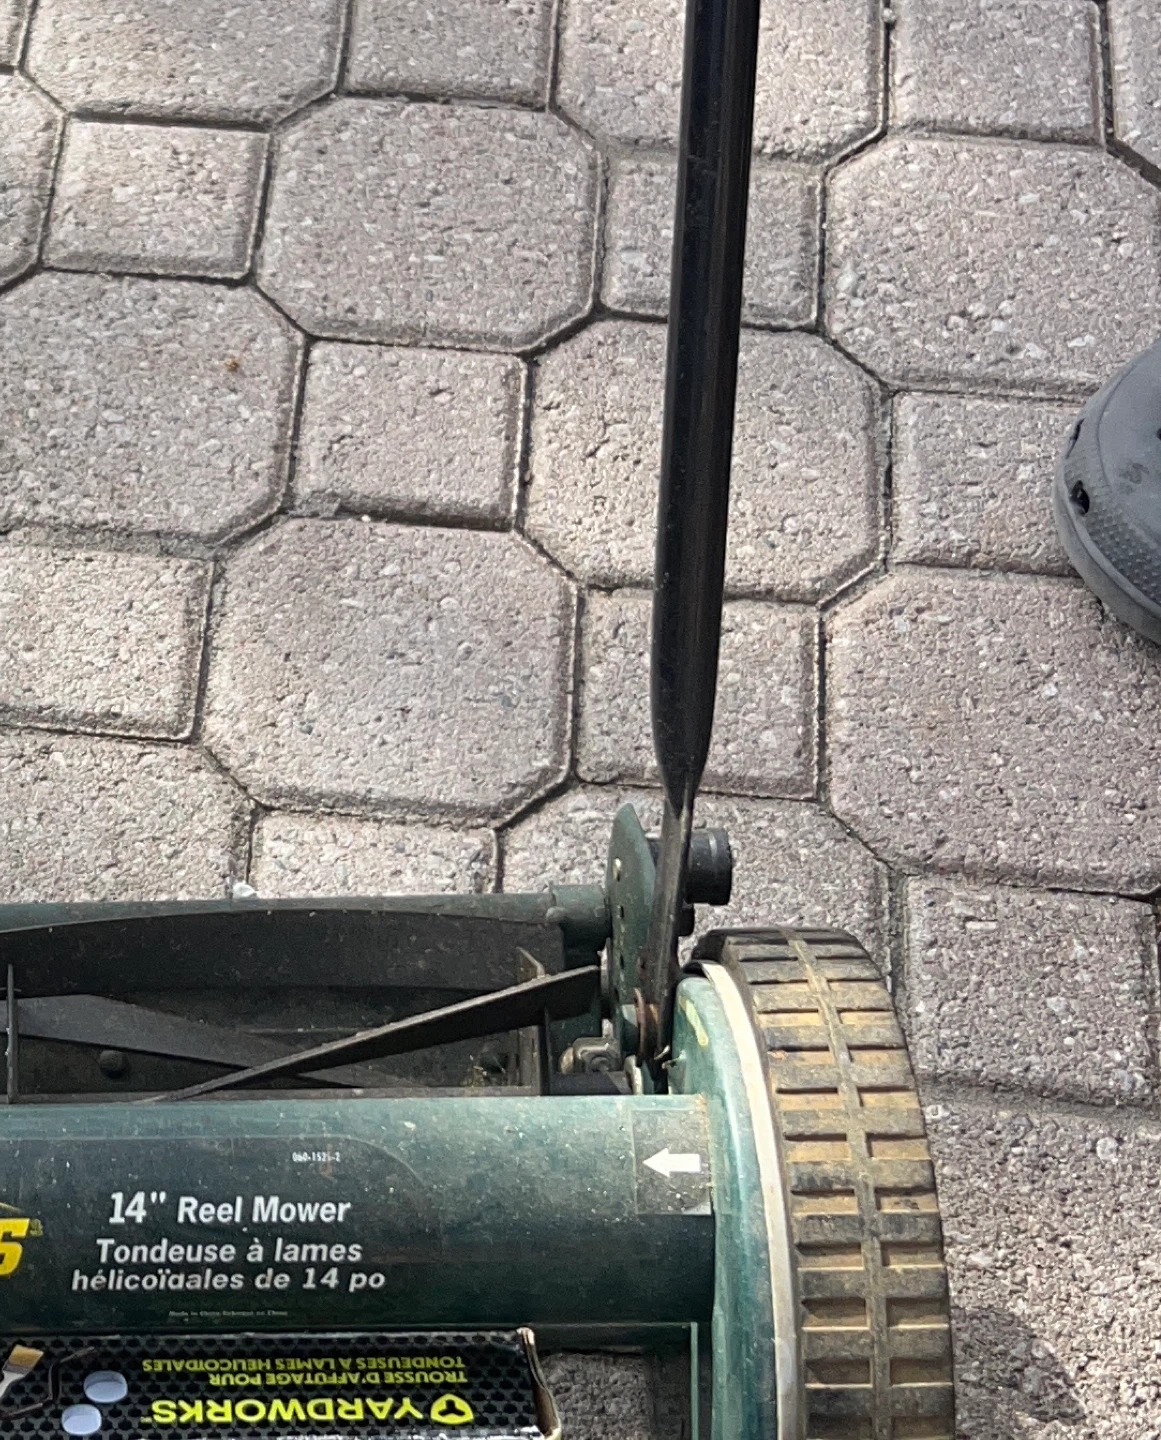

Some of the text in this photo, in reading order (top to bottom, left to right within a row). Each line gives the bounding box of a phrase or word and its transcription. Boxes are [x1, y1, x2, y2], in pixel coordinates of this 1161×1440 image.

[108, 1190, 352, 1224] 14" Reel Mower
[95, 1236, 364, 1264] Tondeuse à lames
[254, 1267, 290, 1291] de
[301, 1266, 340, 1290] 14
[348, 1269, 387, 1293] po
[275, 1357, 335, 1371] LAMES
[355, 1355, 464, 1370] TONDEUSES
[208, 1372, 262, 1386] POUR
[384, 1370, 469, 1384] TROUSSE
[151, 1396, 424, 1423] YARDWORKS
